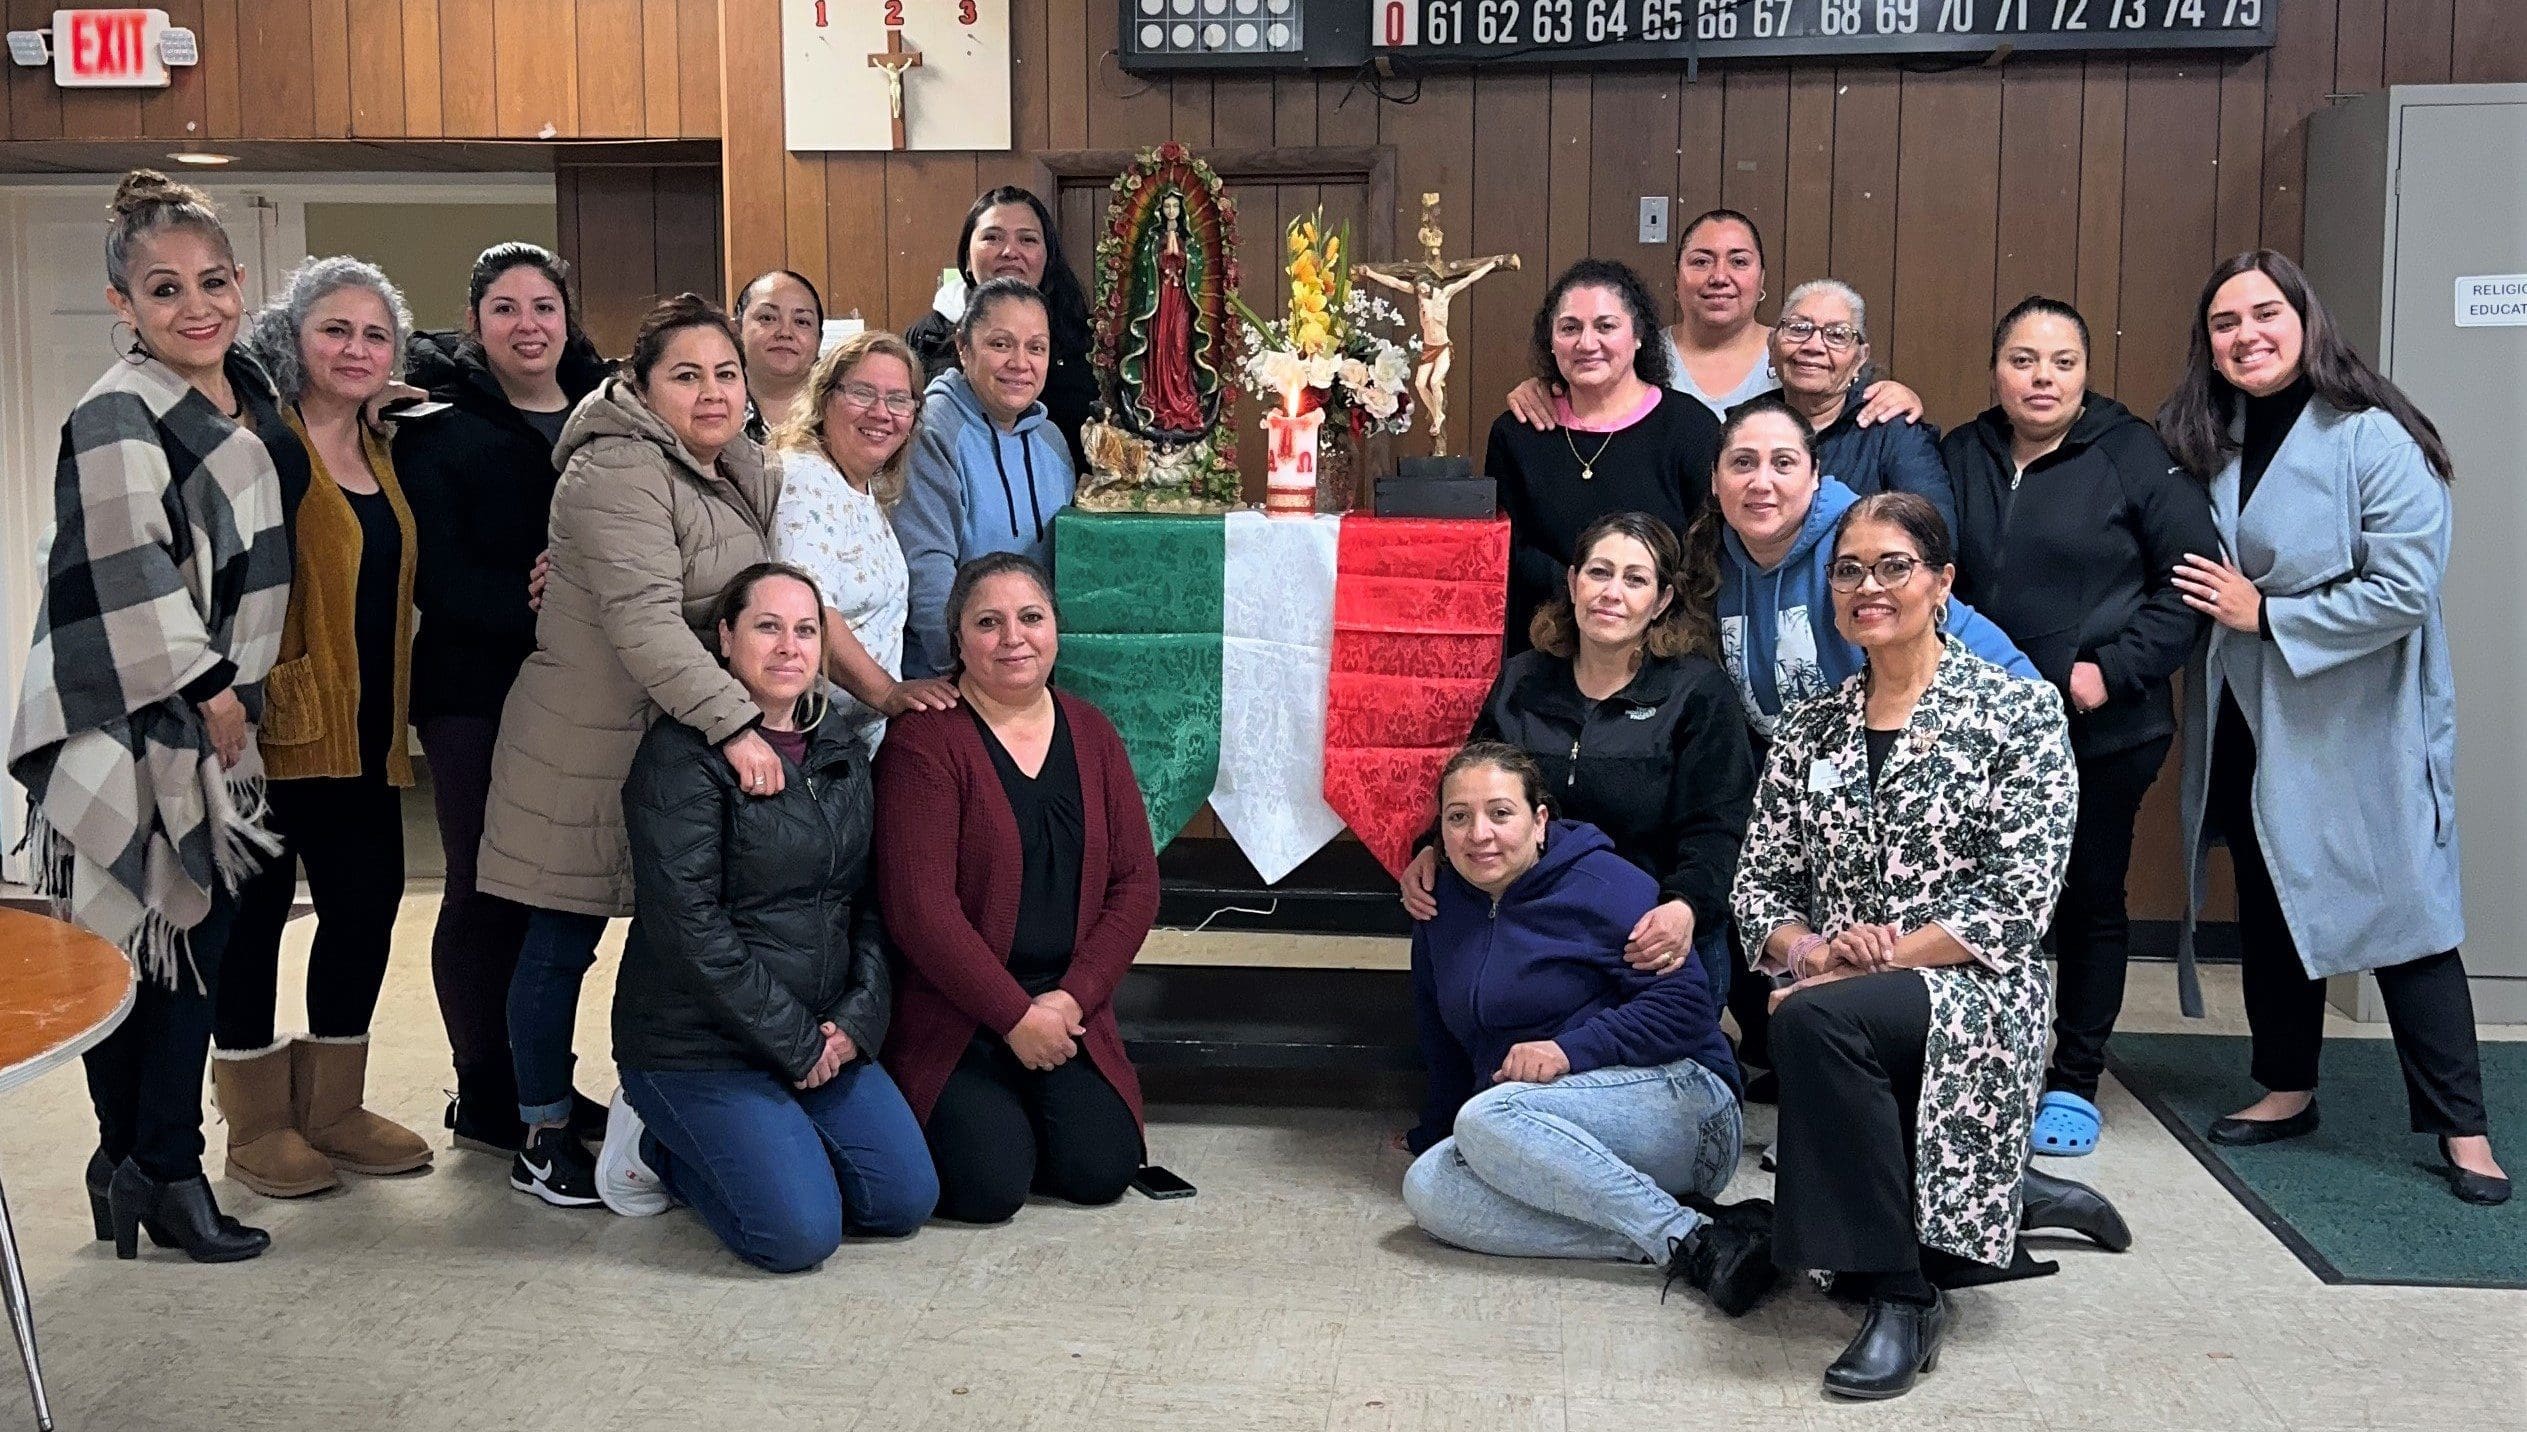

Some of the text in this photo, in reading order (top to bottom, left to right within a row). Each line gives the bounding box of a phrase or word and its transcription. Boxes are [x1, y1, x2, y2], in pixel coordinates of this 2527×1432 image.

[815, 0, 977, 27] 1 2 3
[1428, 1, 1462, 45] 61
[1478, 0, 1519, 44] 62
[1533, 0, 1573, 43] 63
[1586, 0, 1628, 42] 64
[1642, 0, 1683, 41] 65
[1697, 0, 1738, 39] 66
[1753, 0, 1793, 38] 67
[1820, 0, 1861, 36] 68
[1876, 0, 1918, 35] 69
[1936, 0, 1974, 33] 70
[1995, 0, 2028, 31] 71
[2051, 0, 2089, 30] 72
[2108, 0, 2146, 29] 73
[2163, 0, 2206, 28] 74
[2221, 0, 2262, 27] 75
[71, 9, 148, 76] EXIT
[2470, 303, 2527, 315] EDUCAT
